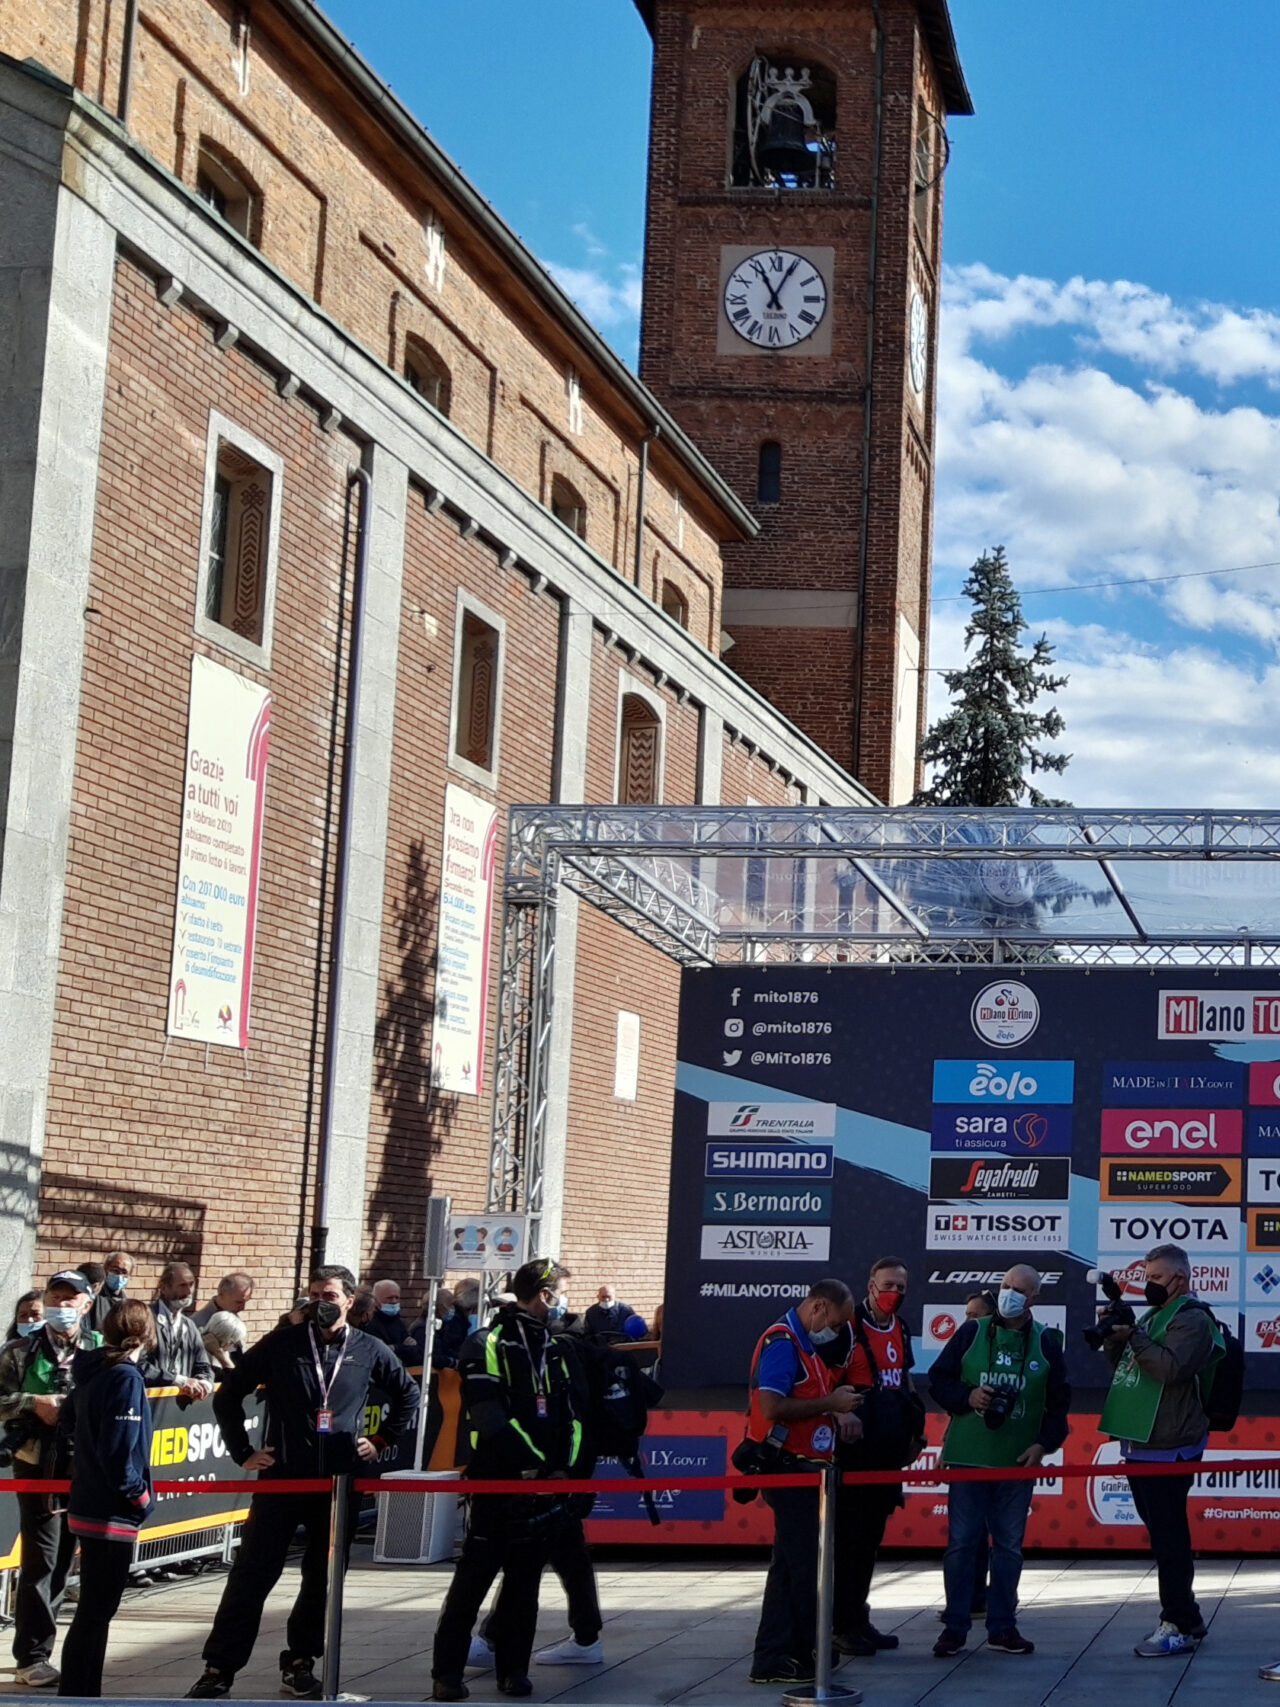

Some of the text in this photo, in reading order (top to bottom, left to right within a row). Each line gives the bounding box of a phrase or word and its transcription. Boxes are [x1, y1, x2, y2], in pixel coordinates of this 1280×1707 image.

[189, 750, 224, 782] Grazie
[188, 783, 239, 816] a tutti voi
[754, 991, 819, 1003] mito1876
[1167, 997, 1245, 1033] MIlano
[752, 1021, 832, 1036] @mito1876
[751, 1051, 832, 1065] @MiTo1876
[969, 1069, 1038, 1100] eolo
[755, 1119, 814, 1128] TRENITALIA
[955, 1116, 1008, 1134] sara
[1125, 1113, 1218, 1150] enel
[955, 1138, 1007, 1148] ti assicura
[712, 1151, 827, 1169] SHIMANO
[960, 1160, 1039, 1192] Segafredo
[1137, 1183, 1192, 1191] SUPERFOOD
[713, 1191, 822, 1212] S.Bernardo
[971, 1215, 1062, 1232] TISSOT
[1110, 1217, 1229, 1240] TOYOTA
[720, 1230, 809, 1250] ASTORIA
[967, 1234, 1008, 1242] WATCHES
[928, 1271, 1063, 1284] LAPIEE
[1112, 1270, 1146, 1281] RASPI
[1191, 1266, 1230, 1279] SPINI
[1191, 1281, 1228, 1292] LUMI
[886, 1341, 897, 1363] 6
[980, 1372, 1026, 1390] PHOTO
